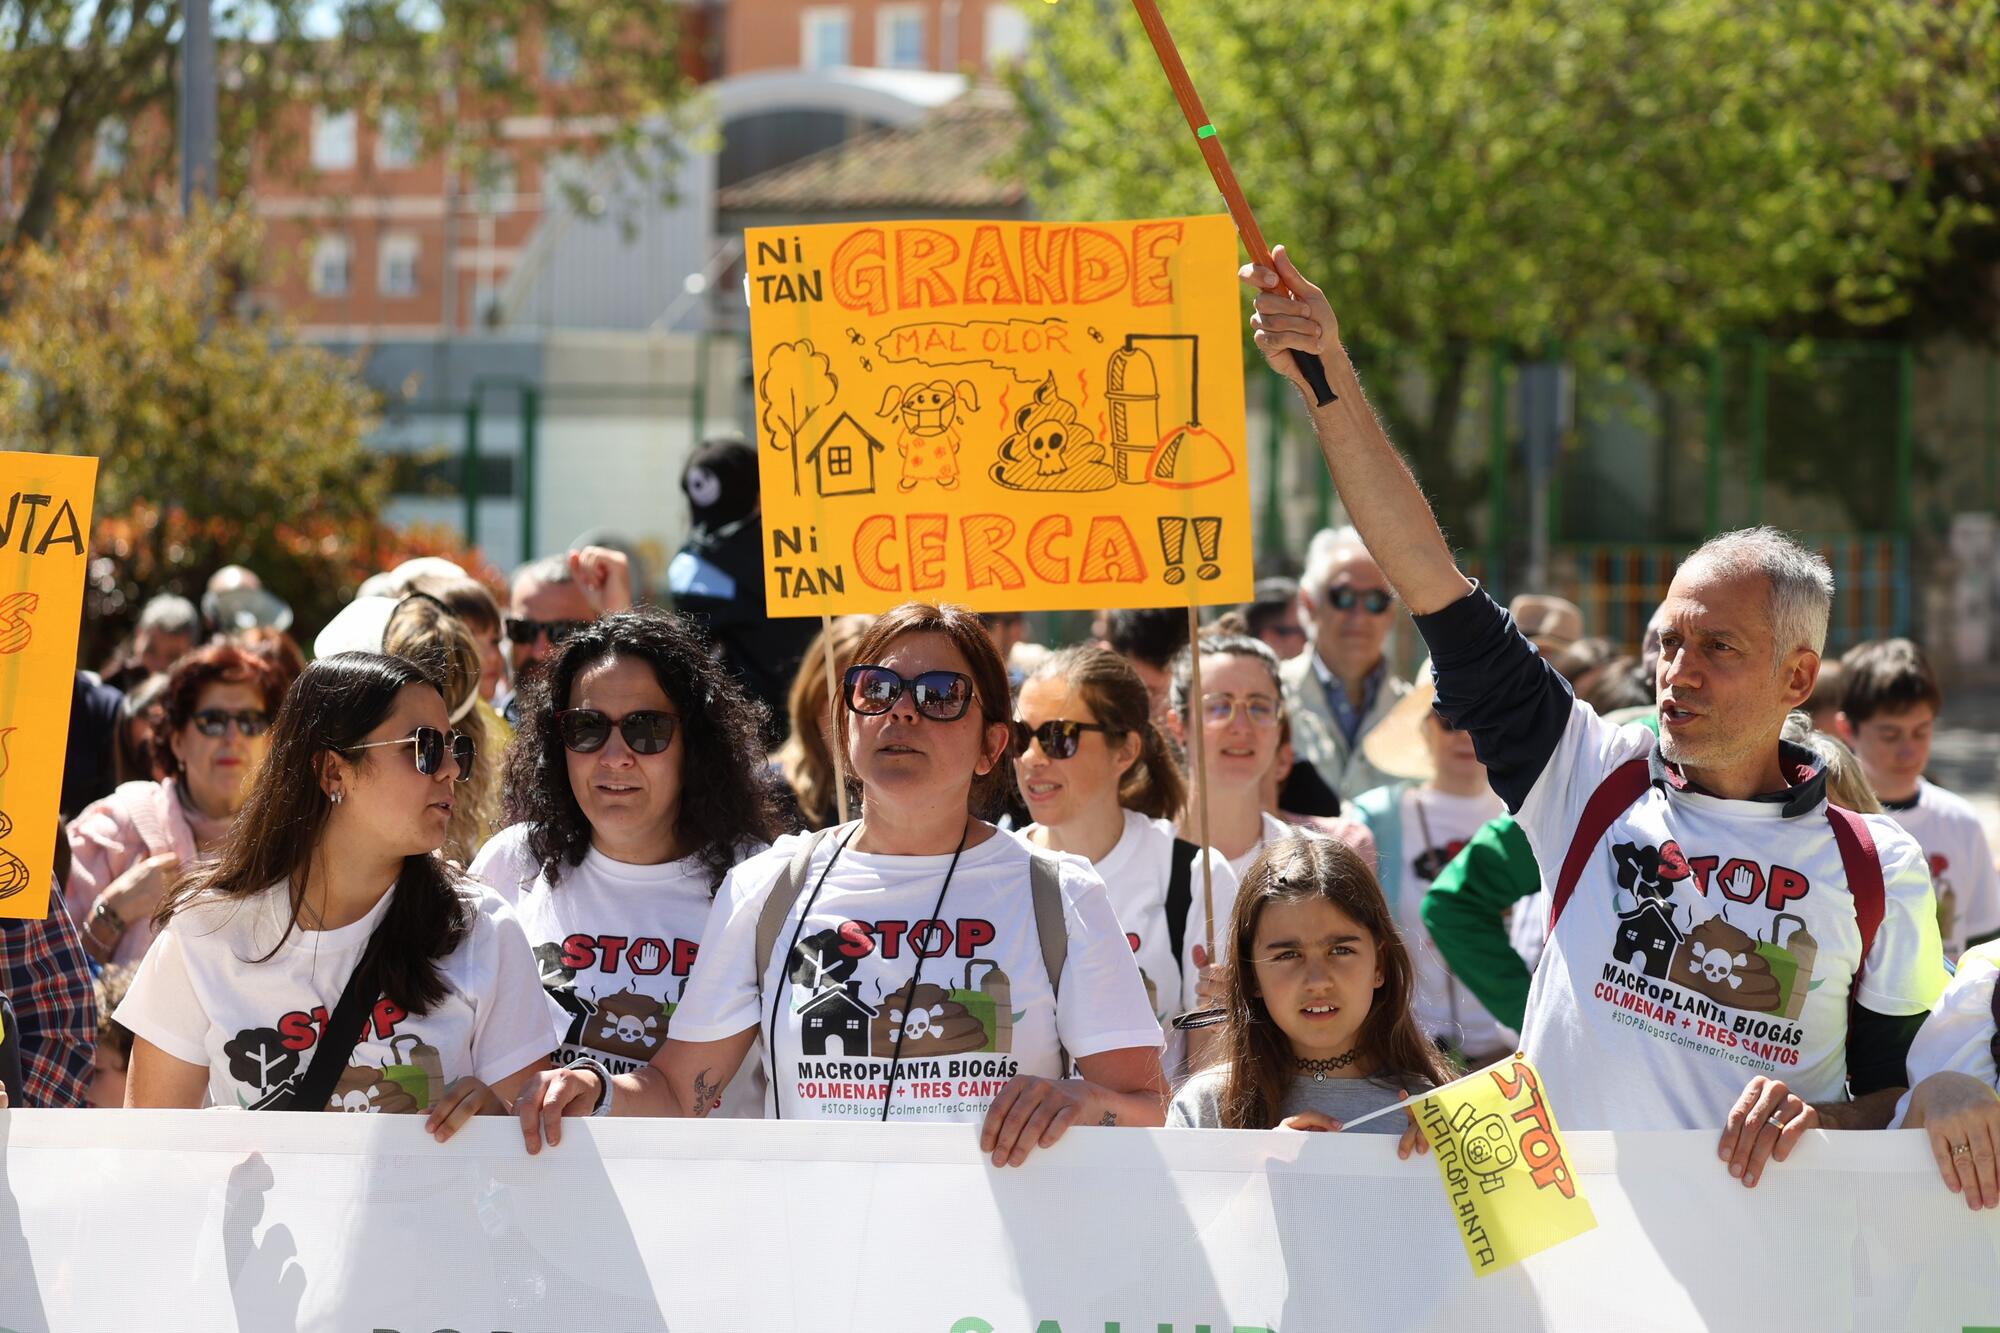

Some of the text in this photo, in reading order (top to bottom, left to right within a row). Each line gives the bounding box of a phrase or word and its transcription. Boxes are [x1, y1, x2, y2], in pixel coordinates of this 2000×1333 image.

[757, 236, 804, 266] Ni
[830, 222, 1186, 316] GRANDE
[757, 269, 824, 304] TAN
[896, 325, 1072, 356] MAL OLOR
[772, 525, 818, 558] Ni
[774, 564, 846, 599] TAN
[1657, 840, 1810, 912] STOP
[837, 918, 996, 959] STOP
[1602, 963, 1804, 1046] MACROPLANTA BIOGÁS
[1594, 982, 1677, 1026] COLMENAR
[1697, 1020, 1738, 1048] TRES
[1741, 1038, 1800, 1066] CANTOS
[1612, 1011, 1776, 1072] #STOPBiogasColmenarTresCantos
[798, 1056, 1018, 1080] MACROPLANTA BIOGÁS
[798, 1082, 891, 1100] COLMENAR
[911, 1081, 952, 1099] TRES
[1490, 1062, 1576, 1199] STOP
